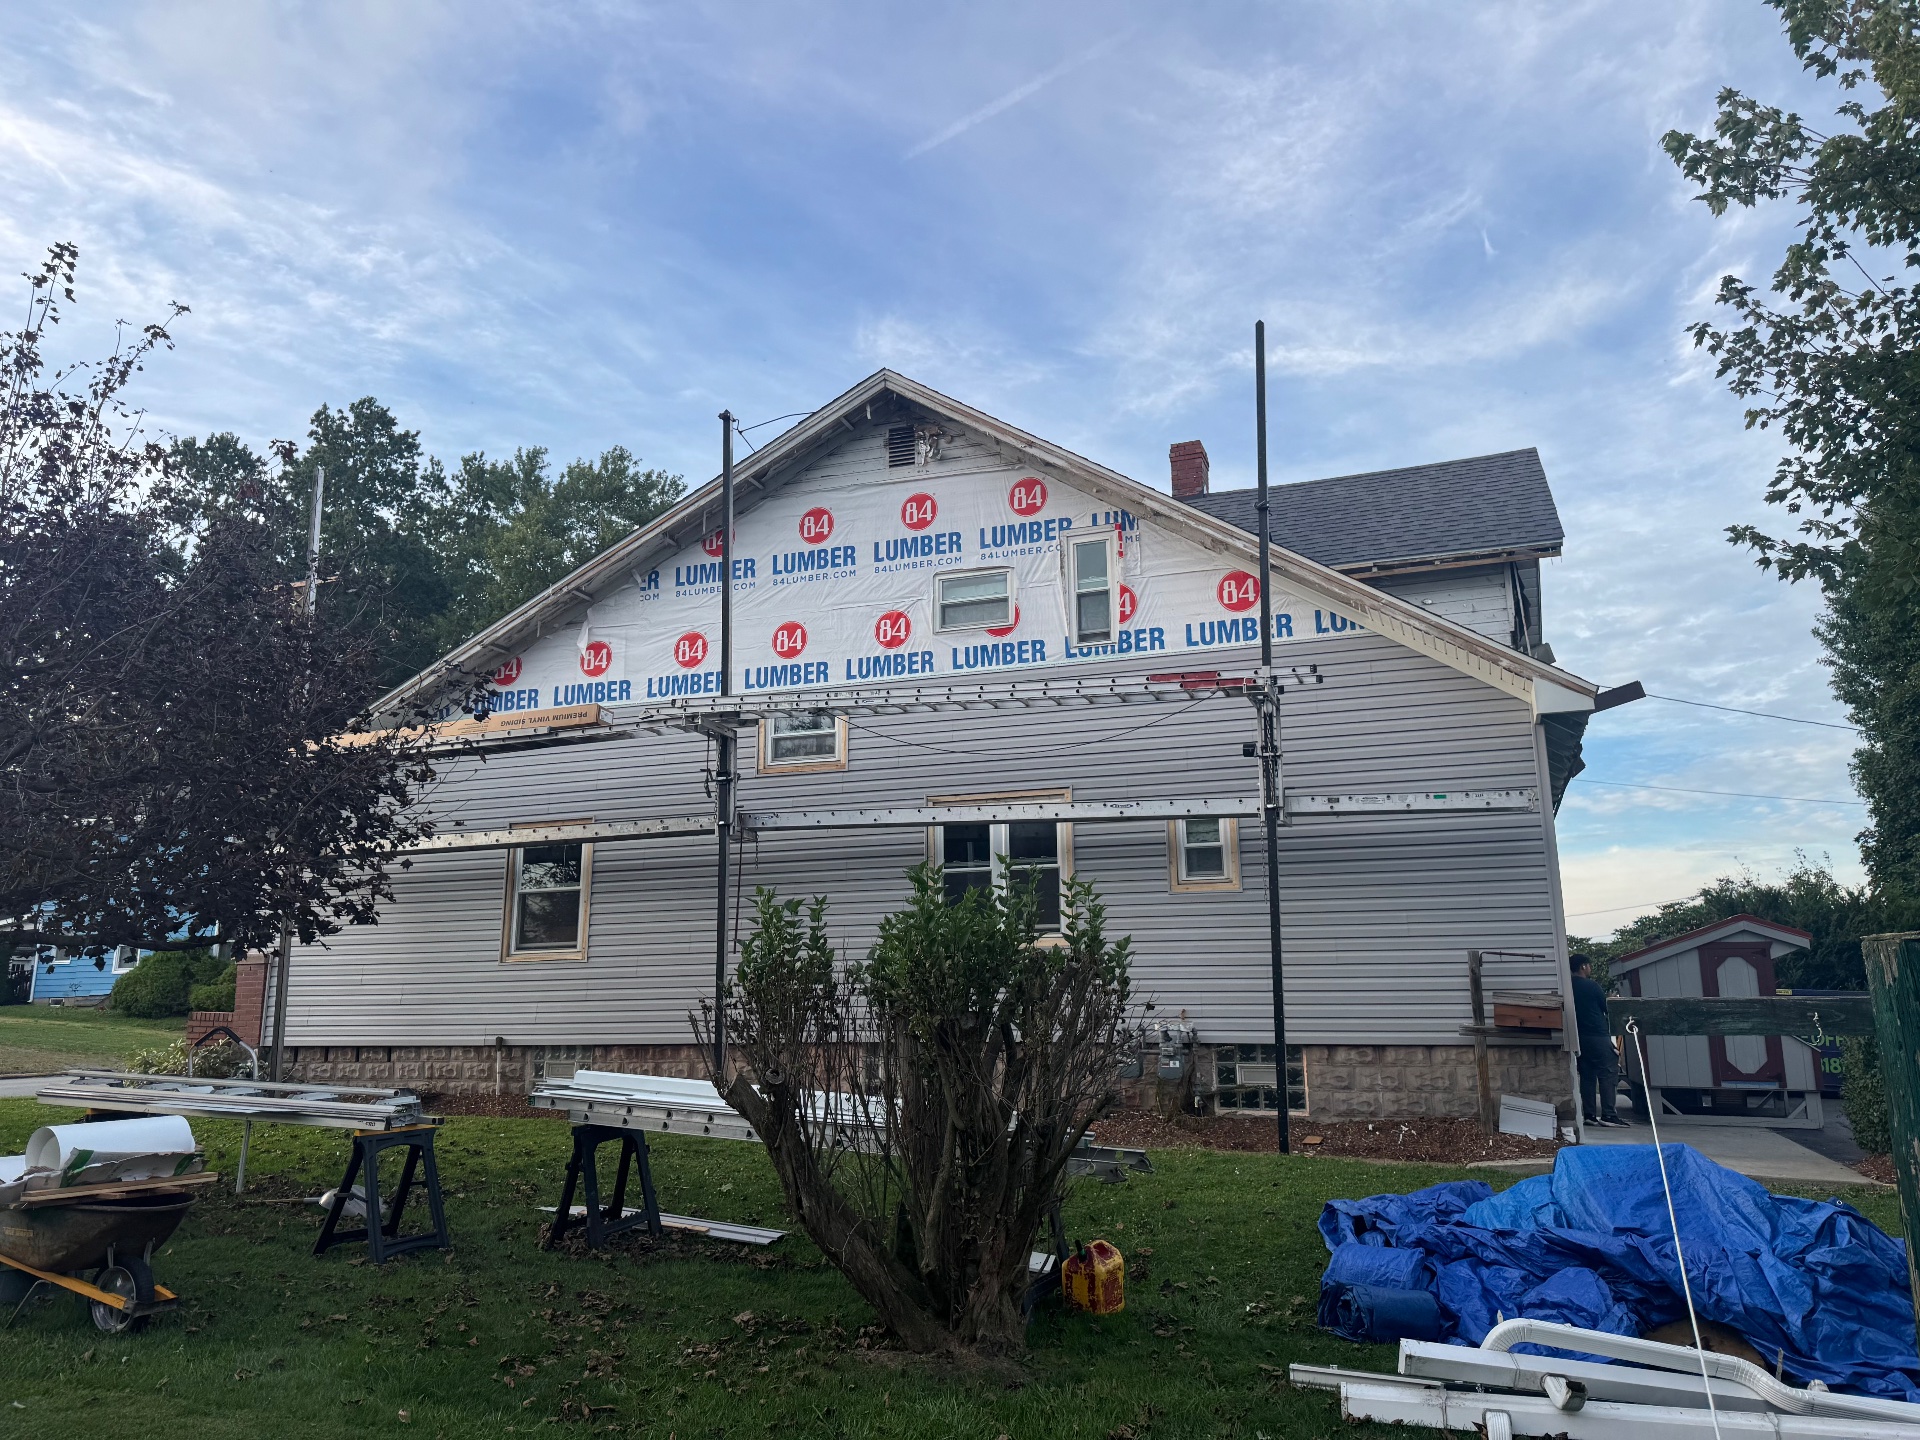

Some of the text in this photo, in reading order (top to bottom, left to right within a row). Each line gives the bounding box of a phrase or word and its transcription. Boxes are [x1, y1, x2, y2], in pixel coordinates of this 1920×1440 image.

[1013, 484, 1043, 510] 84
[905, 499, 934, 524] 84
[802, 514, 828, 537] 84
[873, 532, 962, 563] LUMBER
[675, 558, 756, 587] LUMER
[772, 546, 857, 575] LUMBER
[874, 556, 963, 575] 84LUMBER.COM
[675, 582, 756, 598] 84LUMBECOM
[773, 569, 857, 587] 84LUMBER.COM
[1222, 578, 1256, 604] 84
[777, 628, 804, 653] 84
[879, 618, 907, 642] 84
[1185, 613, 1294, 647] LUMBR
[583, 648, 608, 671] 84
[678, 639, 705, 663] 84
[952, 639, 1046, 670] LUMBER
[745, 661, 829, 690] LUMBER
[846, 651, 934, 681] LUMBER
[553, 680, 632, 707] LUMBER
[500, 711, 588, 727] PREMIUM VINYL SIDING
